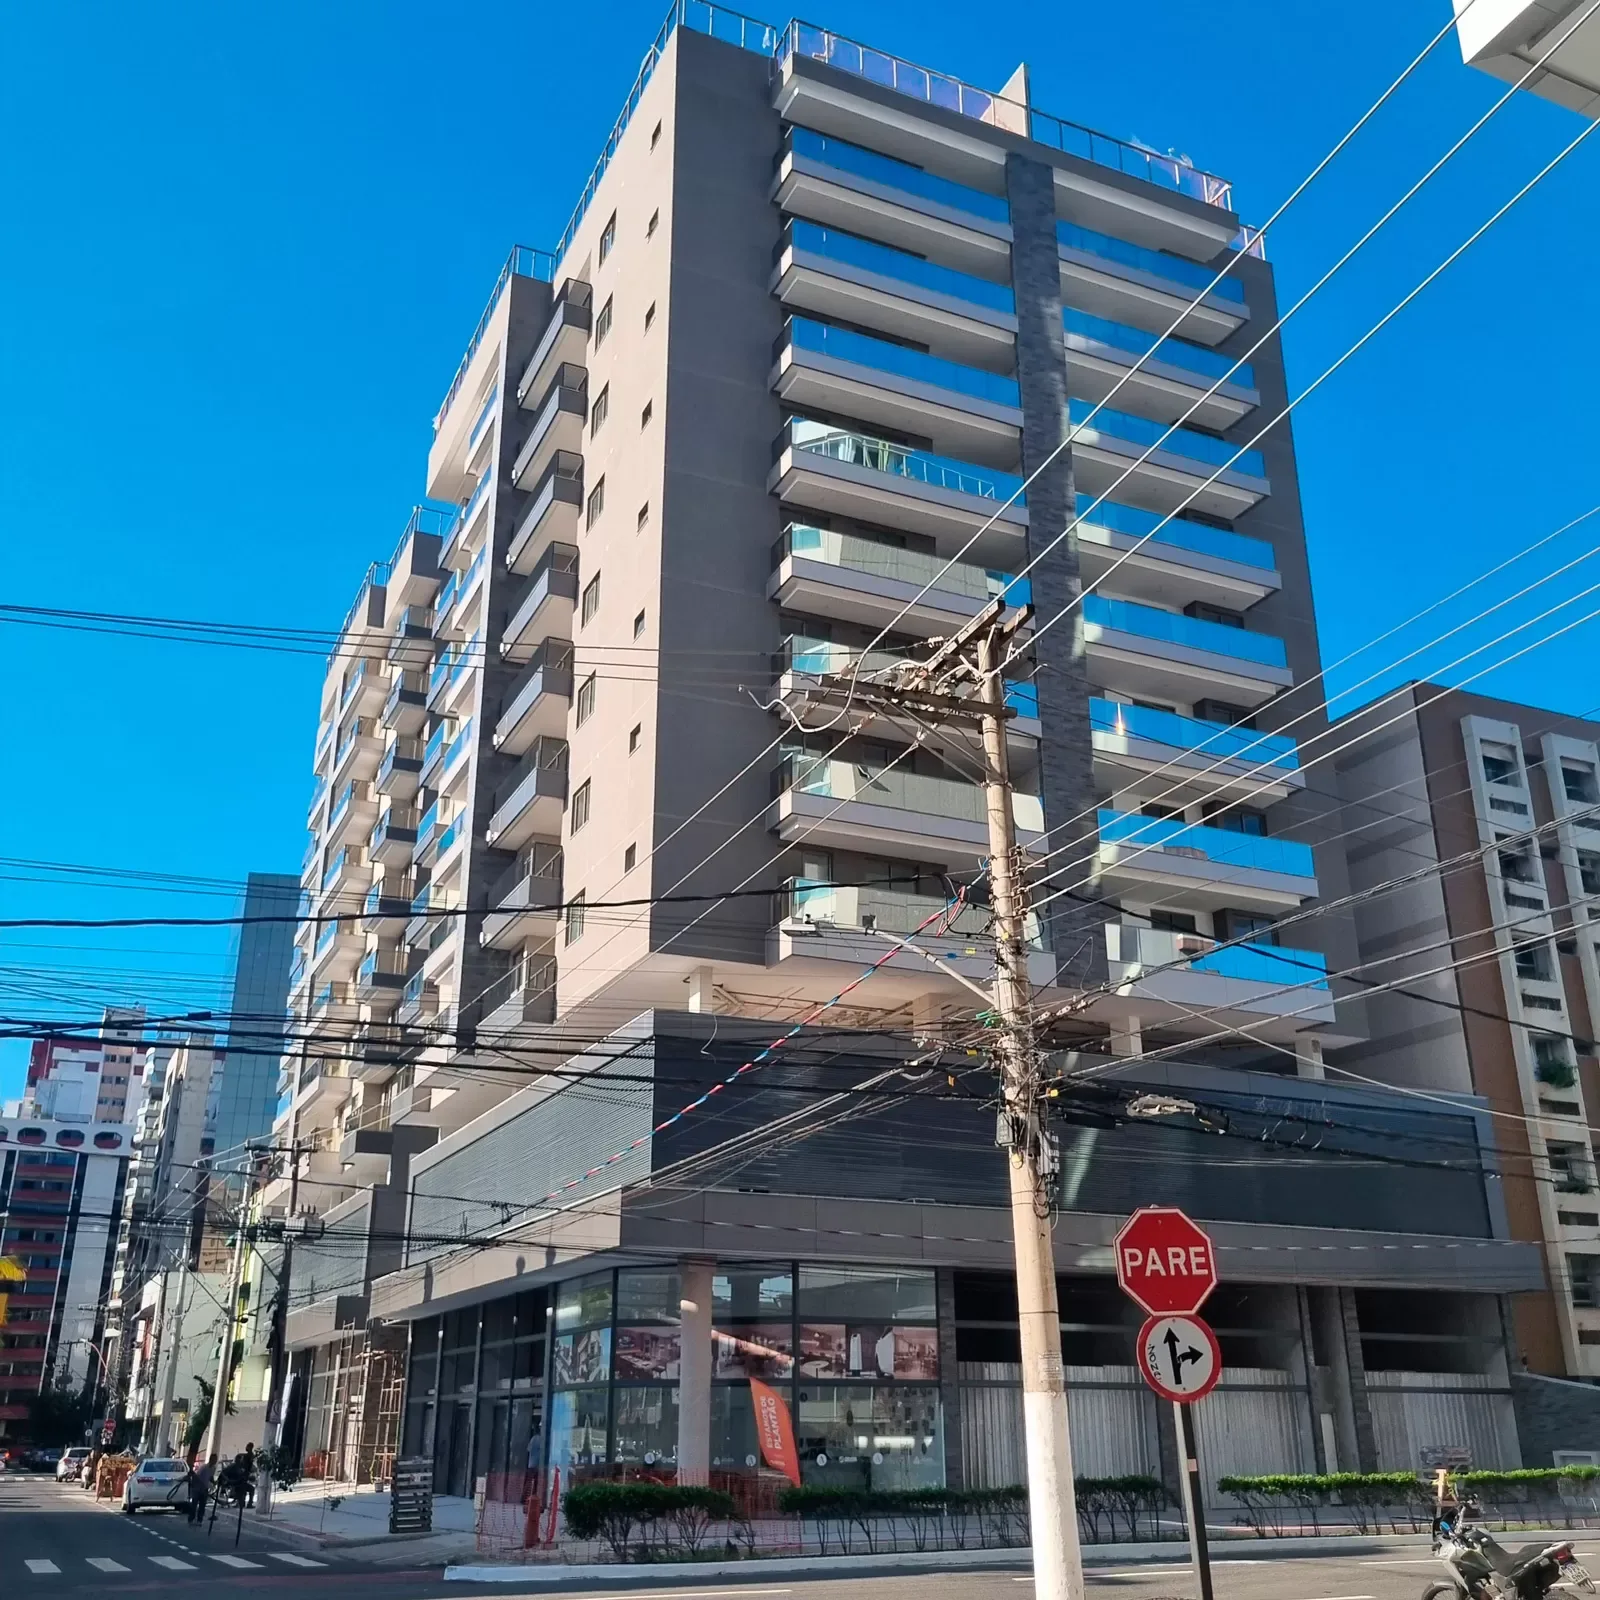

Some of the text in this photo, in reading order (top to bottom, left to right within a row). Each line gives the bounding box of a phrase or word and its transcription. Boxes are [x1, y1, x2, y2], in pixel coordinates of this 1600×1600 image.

[1123, 1246, 1209, 1277] PARE
[762, 1407, 773, 1449] ESTAMOS
[768, 1397, 782, 1449] PLANTÃO
